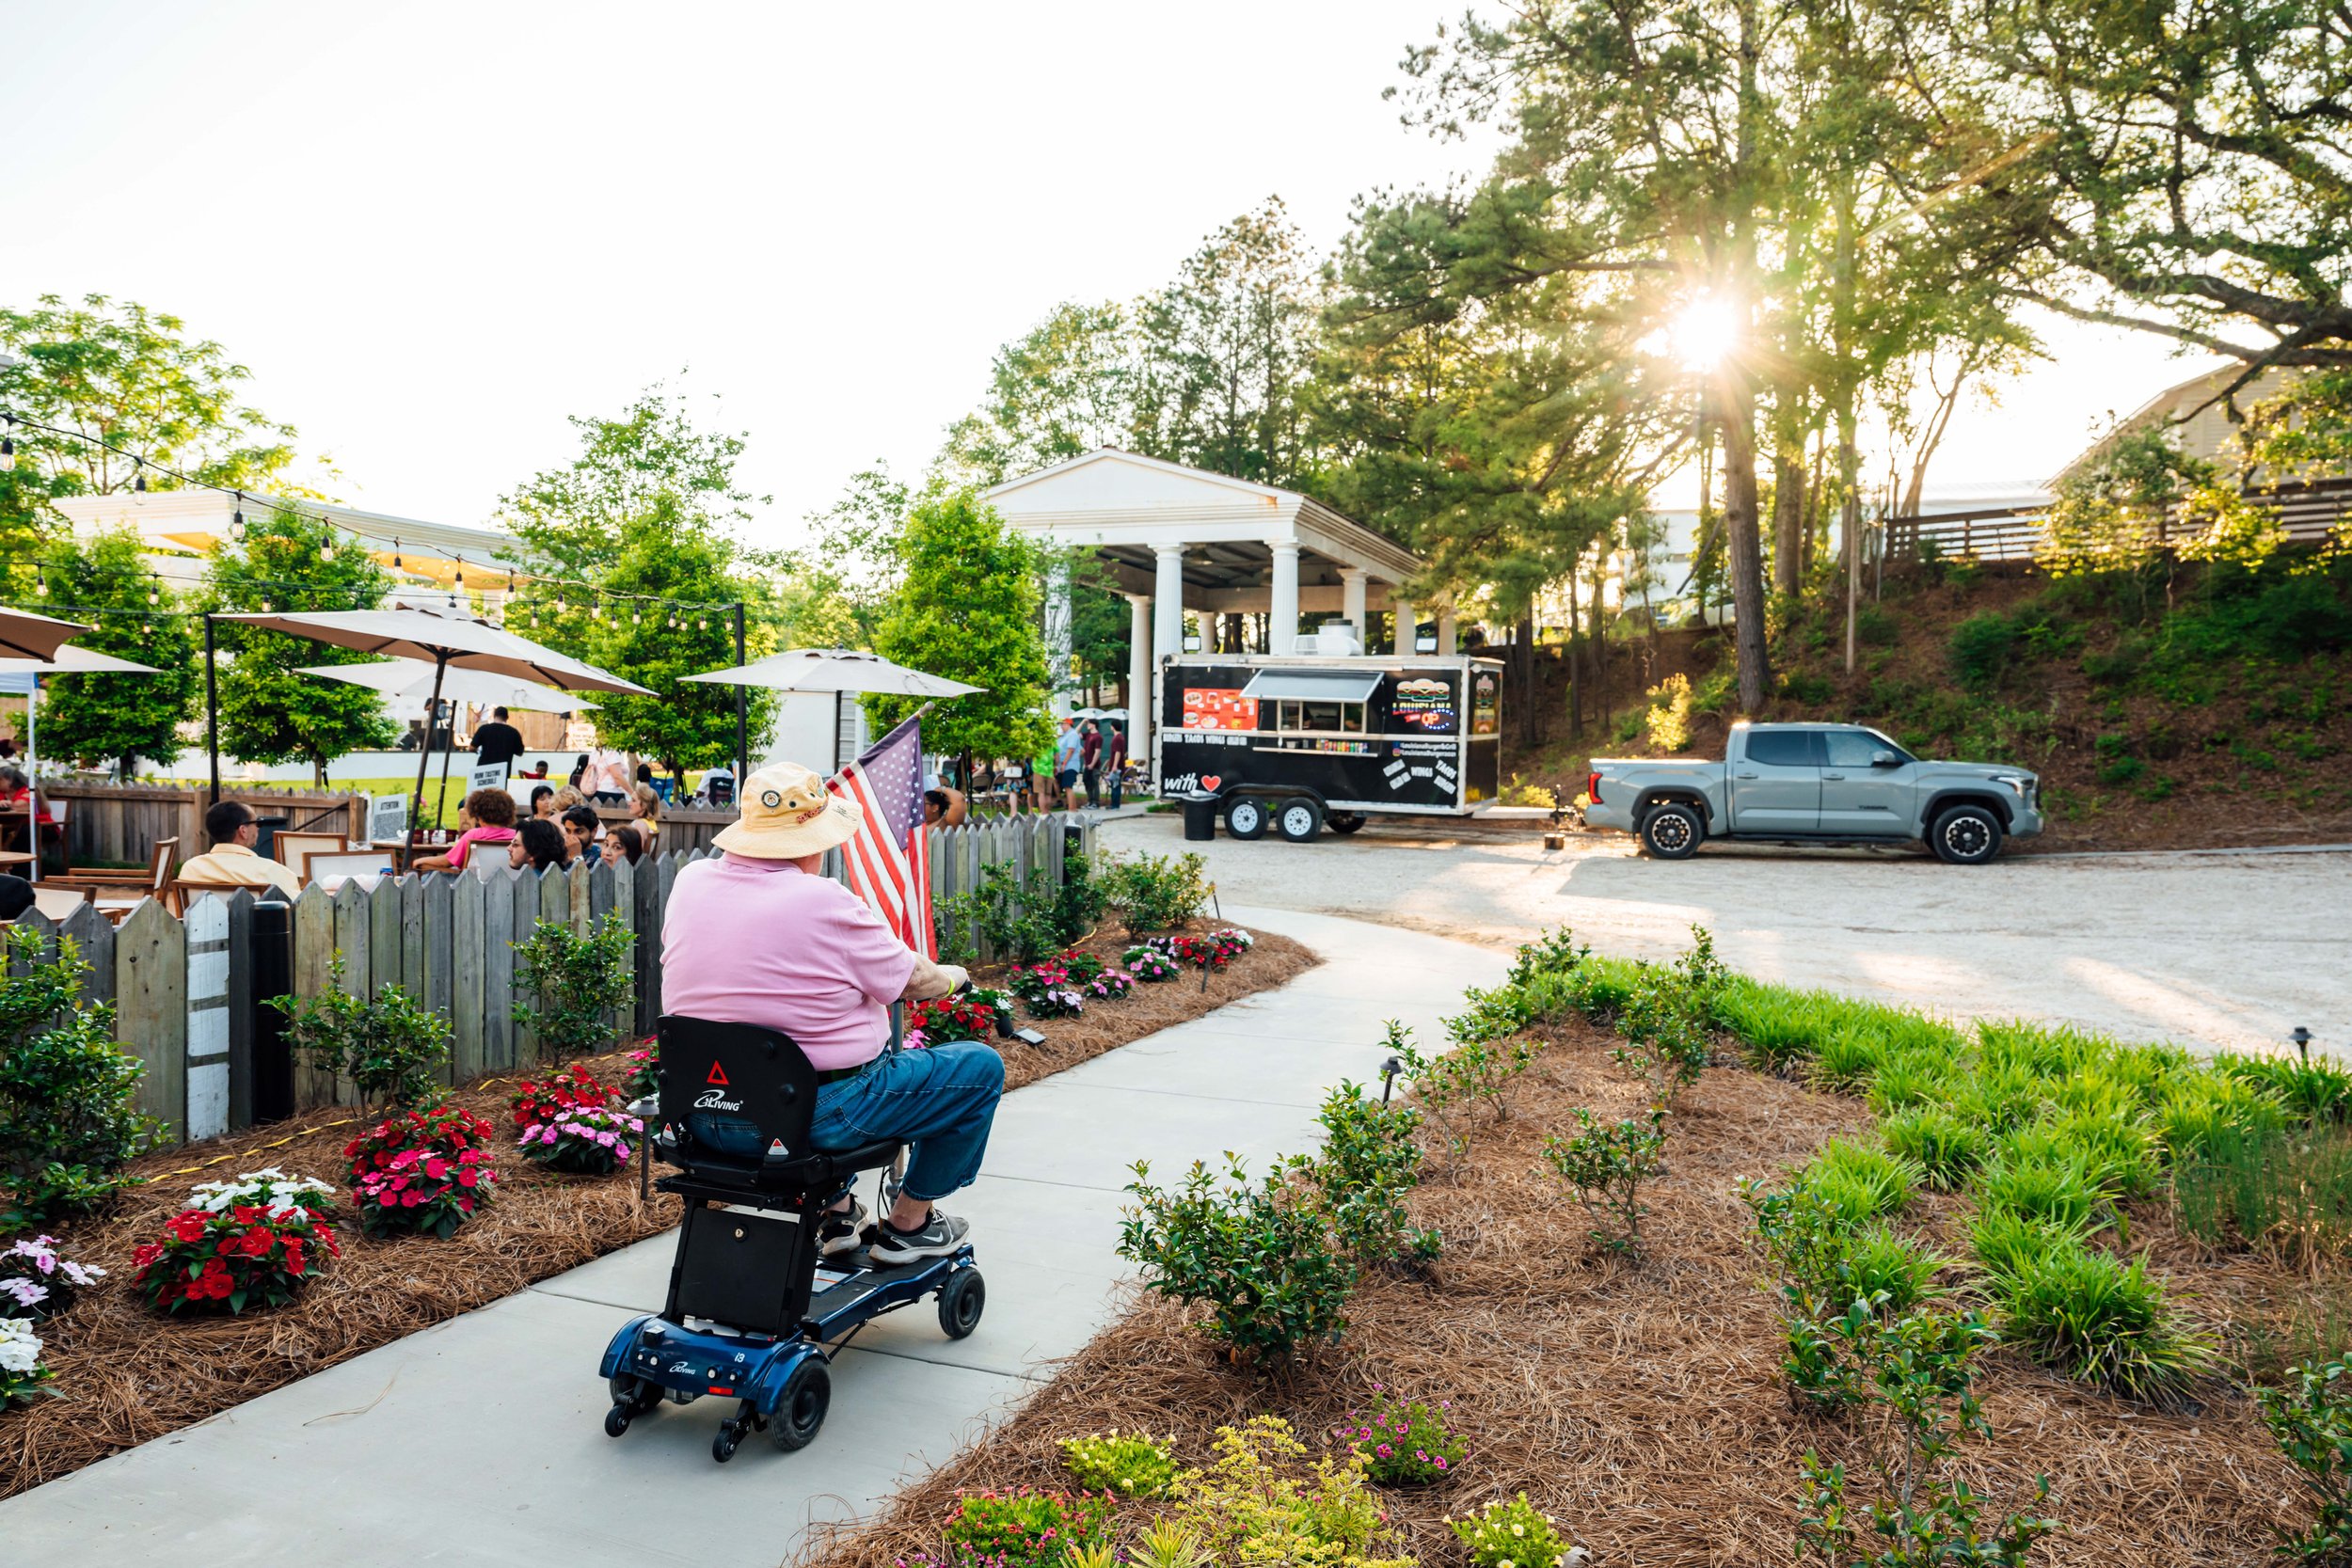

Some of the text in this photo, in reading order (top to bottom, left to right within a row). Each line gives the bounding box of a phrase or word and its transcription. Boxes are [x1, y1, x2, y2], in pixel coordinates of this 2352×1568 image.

[1184, 735, 1204, 743] TACOS
[1411, 767, 1433, 778] WINGS
[1436, 759, 1457, 780] TACOS
[477, 778, 497, 786] SCHEDULE
[1164, 772, 1198, 791] with
[380, 800, 399, 811] ATTENTION
